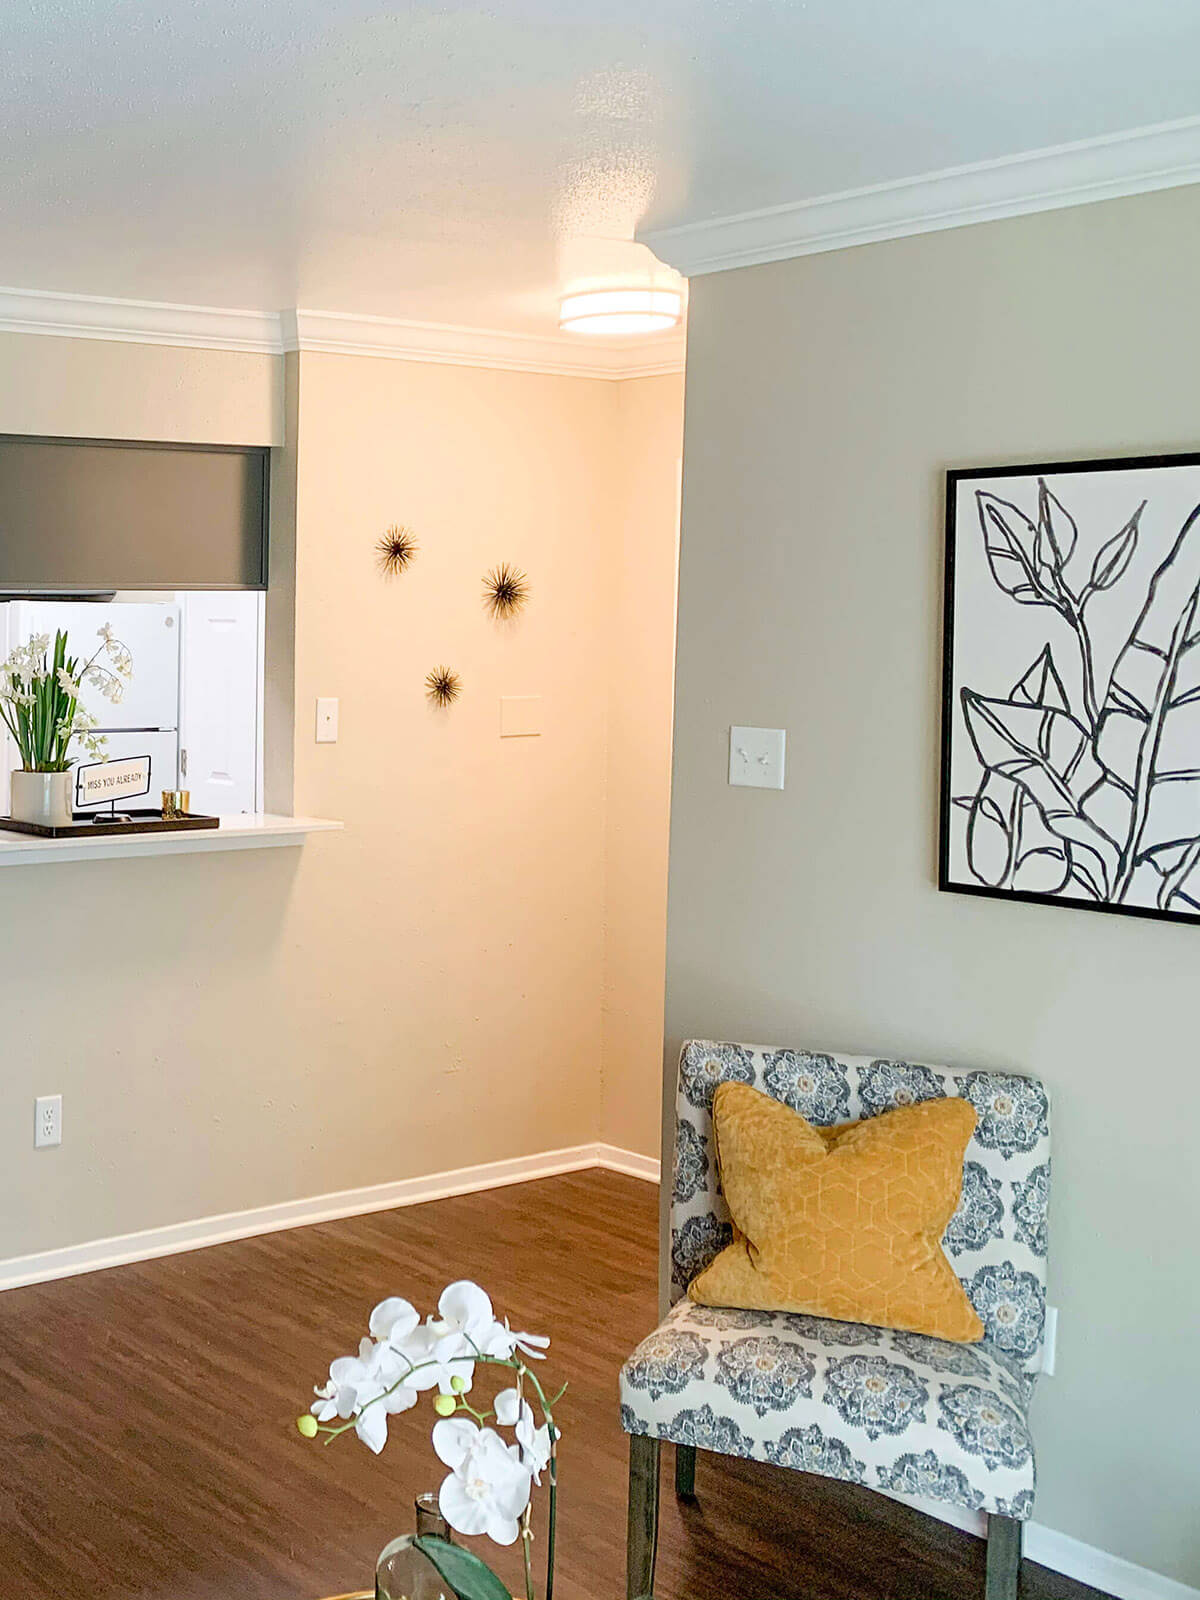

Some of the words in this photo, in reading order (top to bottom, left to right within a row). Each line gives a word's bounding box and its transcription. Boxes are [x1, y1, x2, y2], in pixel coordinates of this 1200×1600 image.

[87, 779, 101, 790] MISS
[103, 776, 115, 787] YOU
[116, 772, 142, 785] ALREADY
